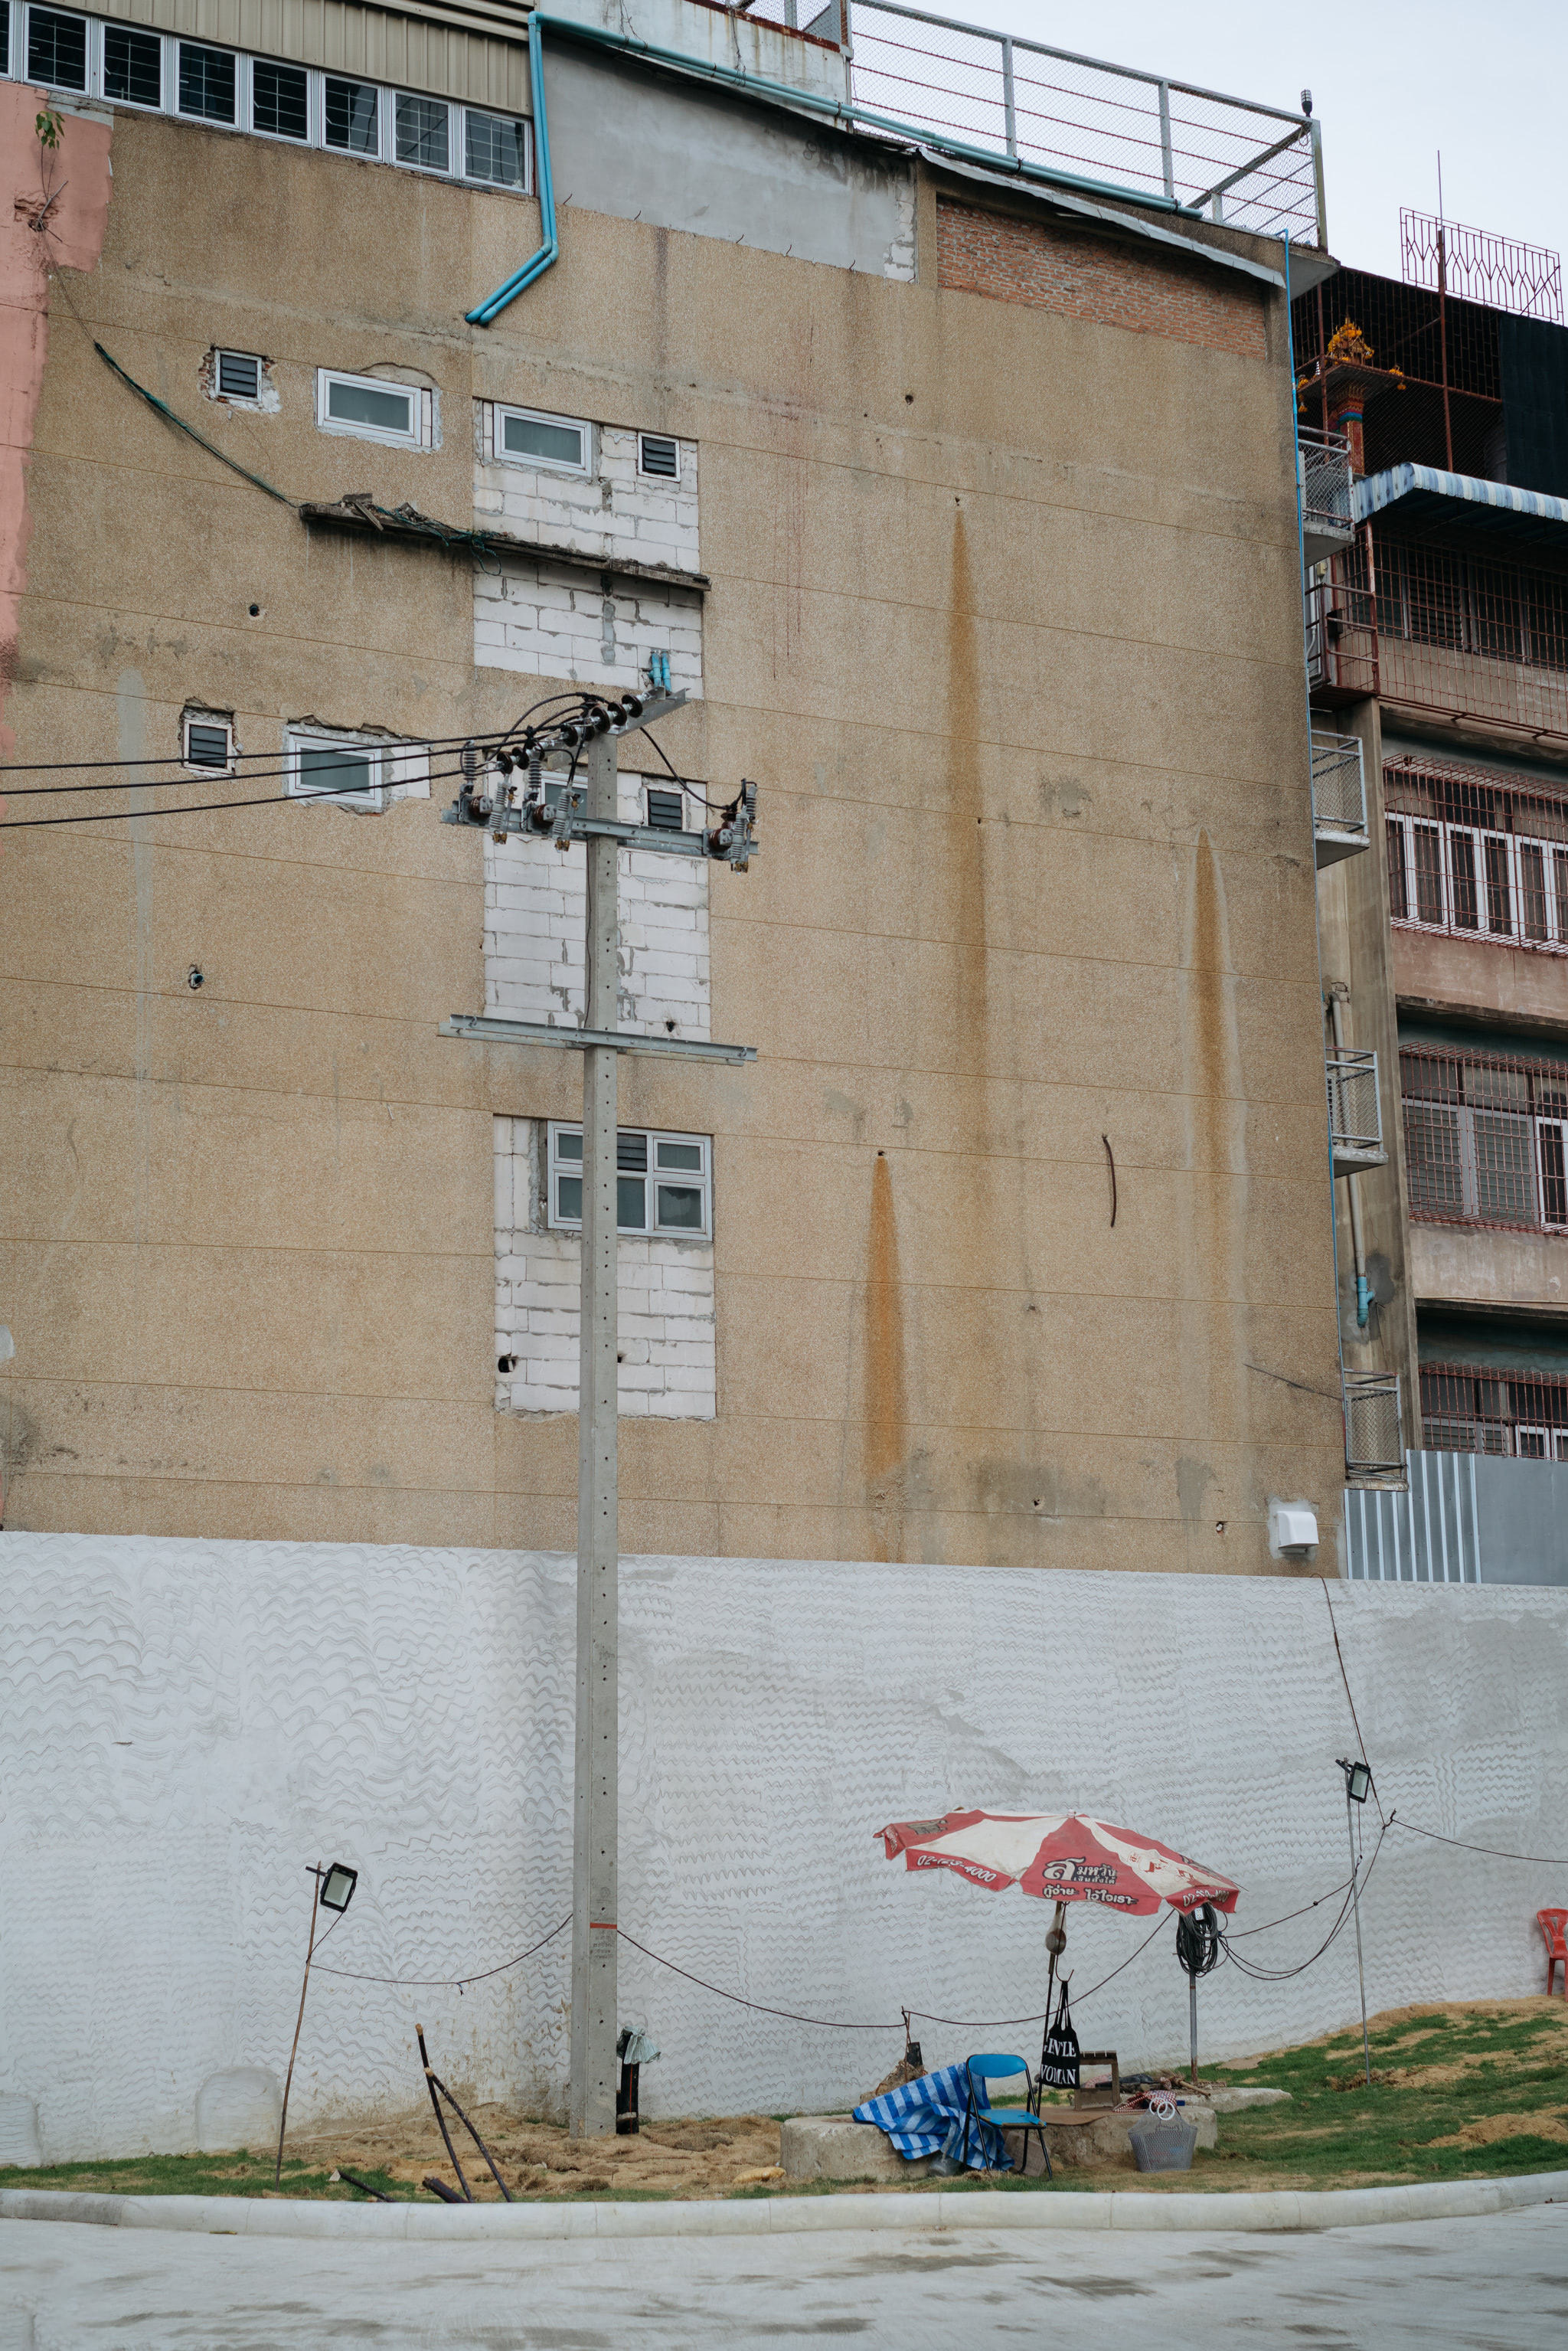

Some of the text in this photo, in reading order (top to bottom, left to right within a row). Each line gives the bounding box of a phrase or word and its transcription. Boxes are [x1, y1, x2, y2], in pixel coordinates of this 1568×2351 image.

[1043, 1856, 1117, 1882] สมหวัง
[1084, 1887, 1135, 1905] ไว้ใจเรา
